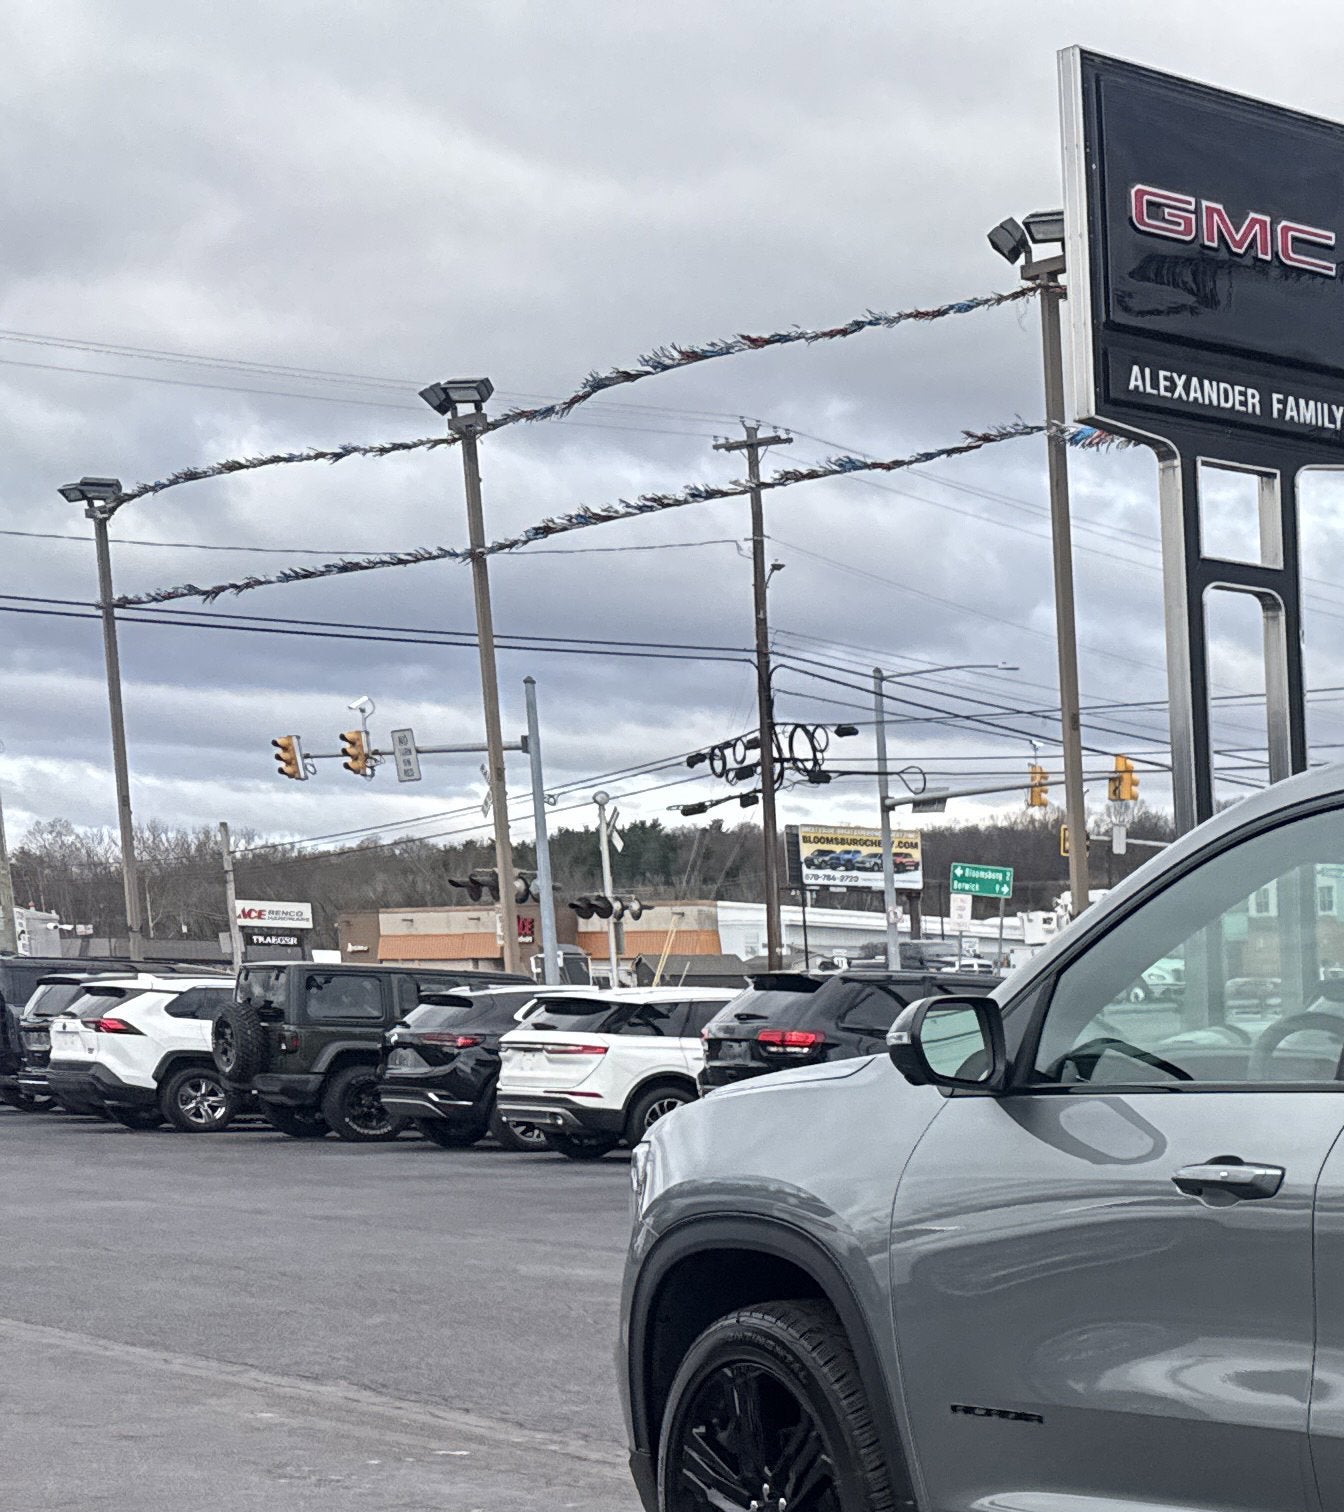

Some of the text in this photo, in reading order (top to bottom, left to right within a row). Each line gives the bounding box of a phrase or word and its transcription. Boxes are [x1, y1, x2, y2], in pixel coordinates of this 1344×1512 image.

[1130, 183, 1336, 277] GMC
[1128, 364, 1344, 431] ALEXANDER FAMILY
